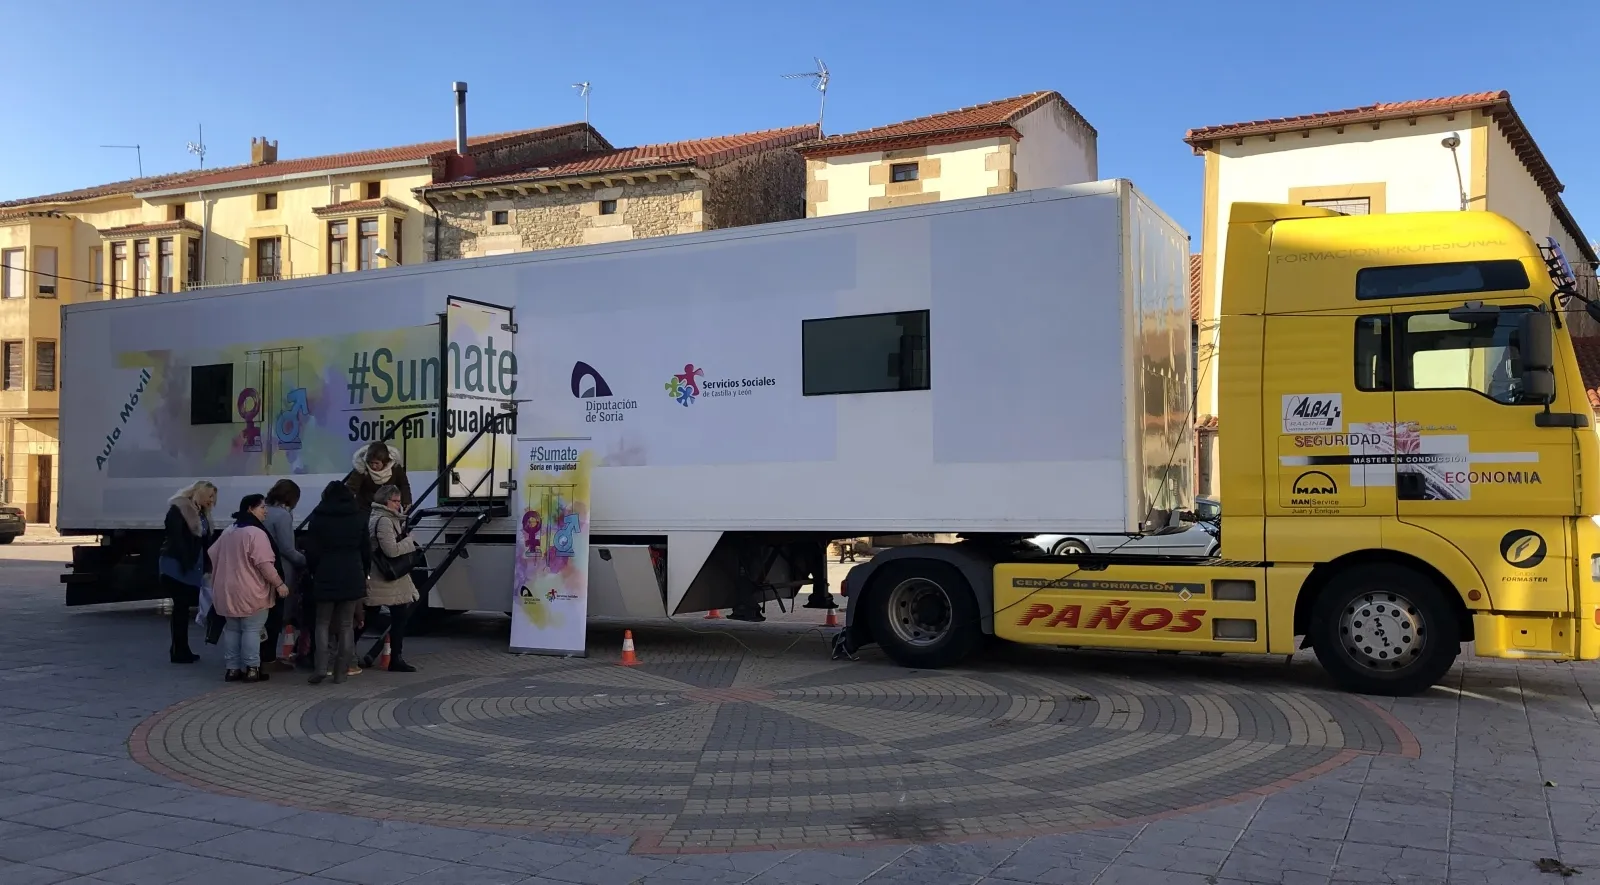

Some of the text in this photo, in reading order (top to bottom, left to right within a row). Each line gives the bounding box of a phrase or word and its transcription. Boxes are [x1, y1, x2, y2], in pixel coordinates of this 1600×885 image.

[347, 336, 518, 404] #Sumate
[702, 377, 776, 389] Servicios Sociales
[711, 389, 732, 397] Castilla
[585, 399, 638, 413] Diputación
[1293, 397, 1332, 417] ALBA
[96, 367, 152, 471] Aula Móvil
[585, 411, 624, 423] de Soria
[348, 414, 396, 442] Soria
[402, 415, 424, 439] en
[1294, 433, 1382, 448] SEGURIDAD
[530, 446, 578, 461] #Sumate
[530, 463, 545, 471] Soria
[553, 463, 577, 472] igualdad
[1445, 470, 1542, 484] ECONOMIA
[1016, 579, 1068, 588] CENTRO
[1072, 580, 1088, 588] de
[1016, 600, 1207, 633] PAÑOS
